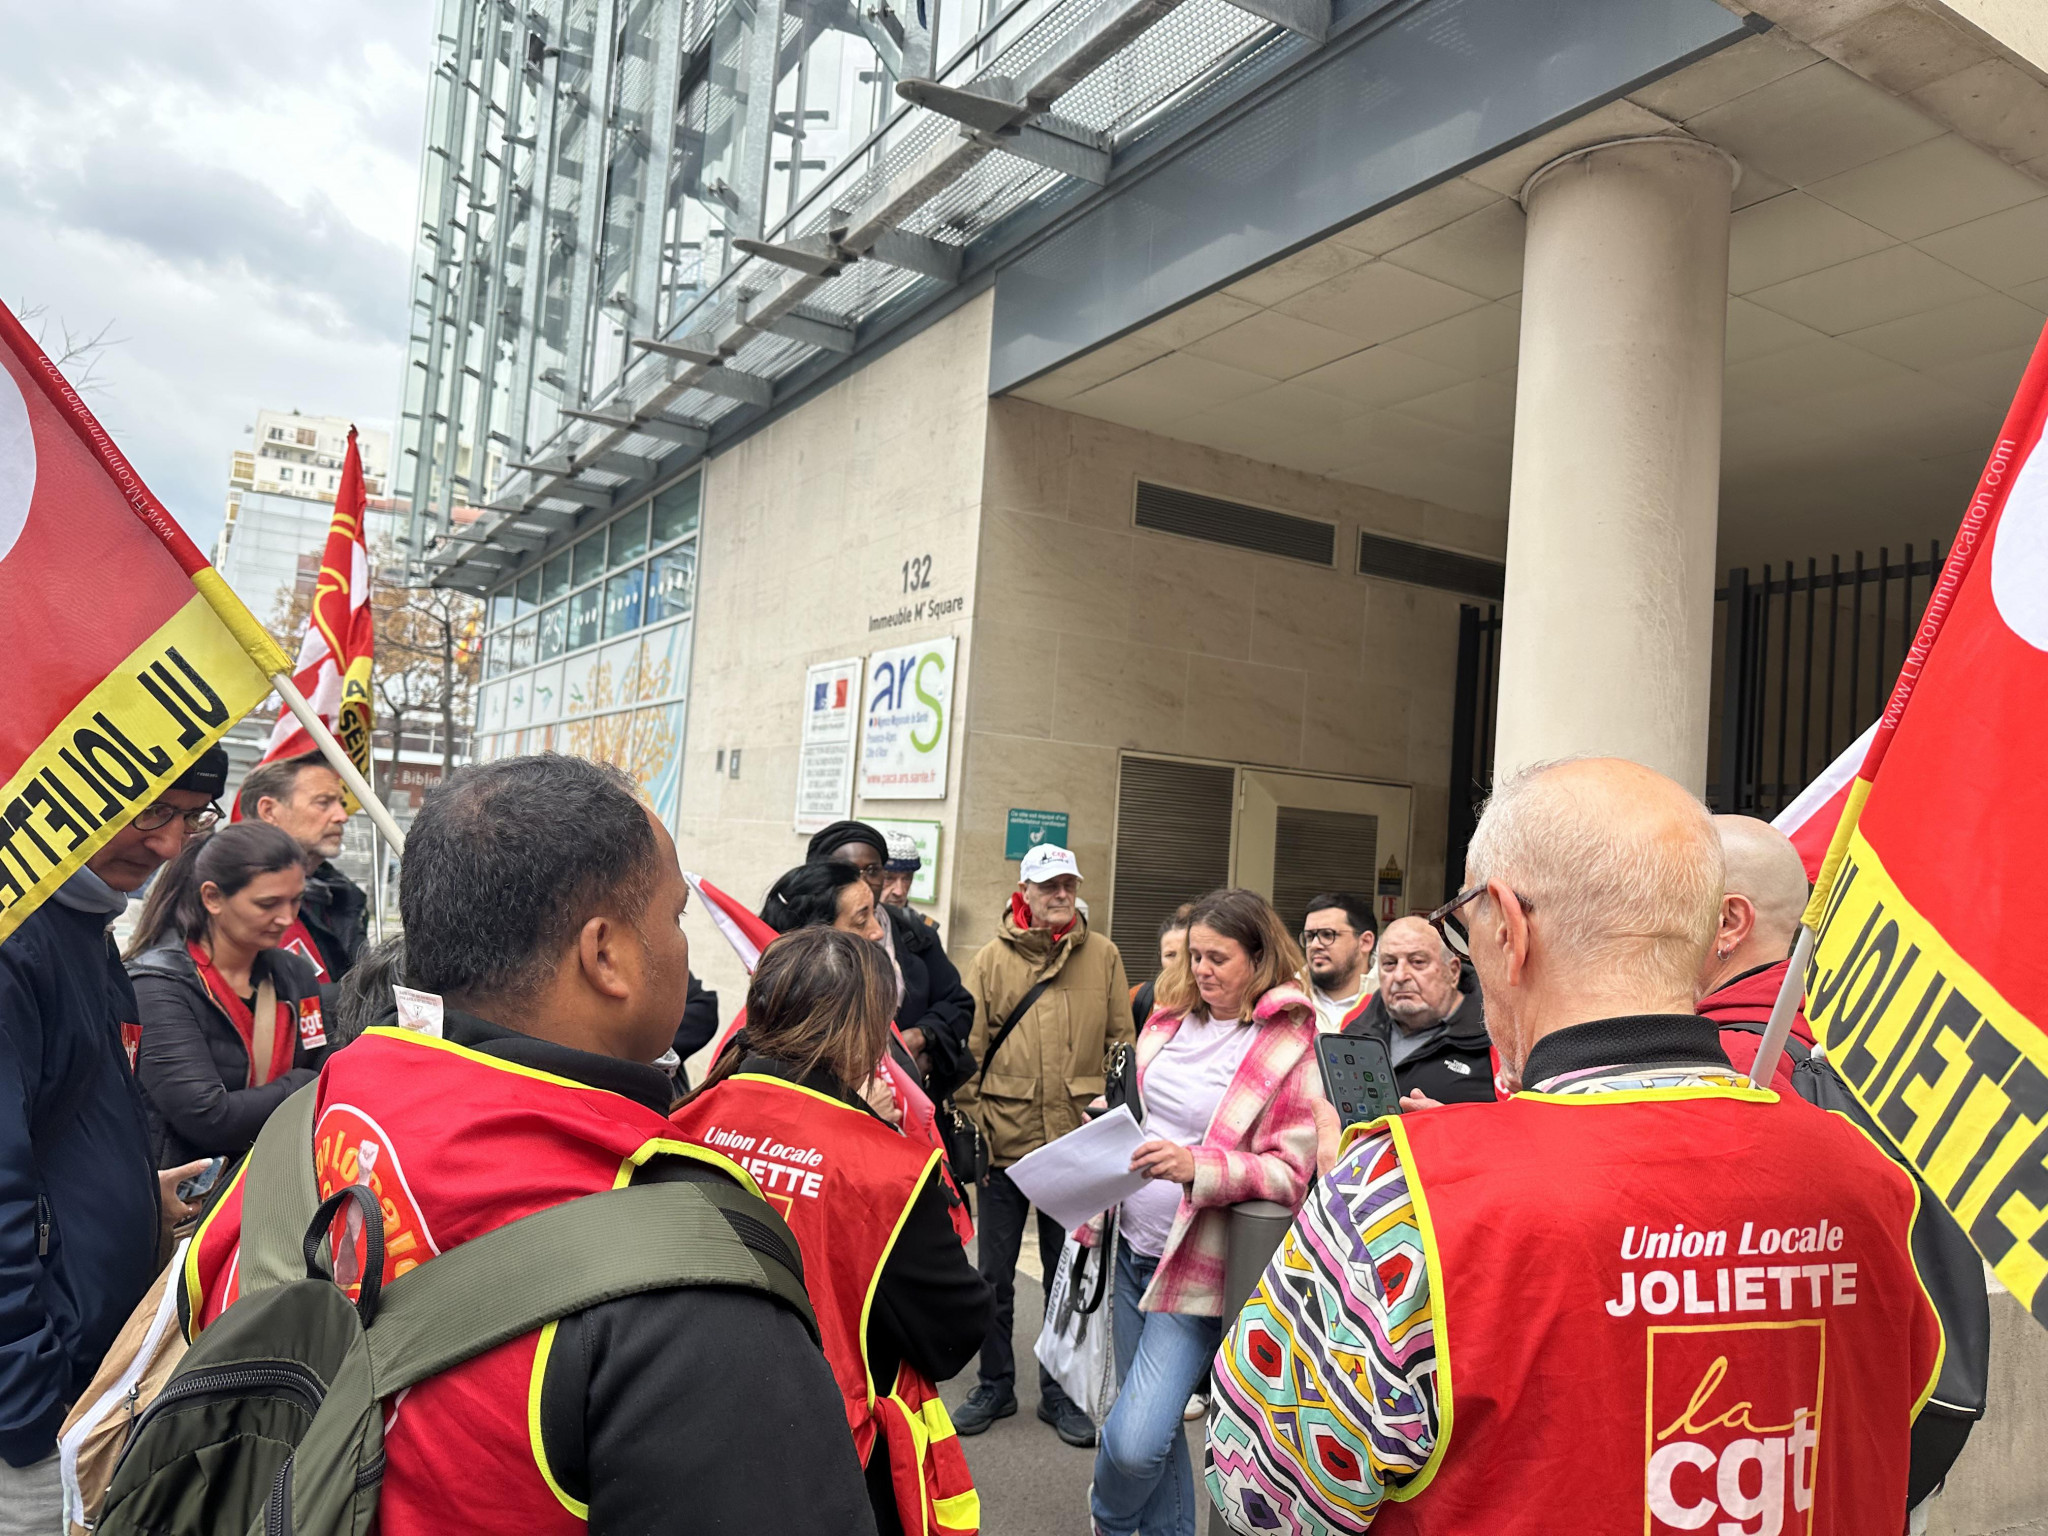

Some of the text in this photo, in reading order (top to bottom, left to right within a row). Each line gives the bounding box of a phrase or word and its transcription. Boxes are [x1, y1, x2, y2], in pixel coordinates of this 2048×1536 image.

[901, 554, 932, 594] 132
[1881, 438, 2016, 730] www.LMcommunication.com
[868, 606, 913, 633] Immeuble
[927, 597, 964, 621] Square
[869, 652, 946, 753] ars
[703, 1126, 824, 1167] Union Locale
[1620, 1218, 1844, 1260] Union Locale
[1605, 1262, 1858, 1318] JOLIETTE
[1656, 1355, 1818, 1441] la
[1646, 1406, 1818, 1536] cgt
